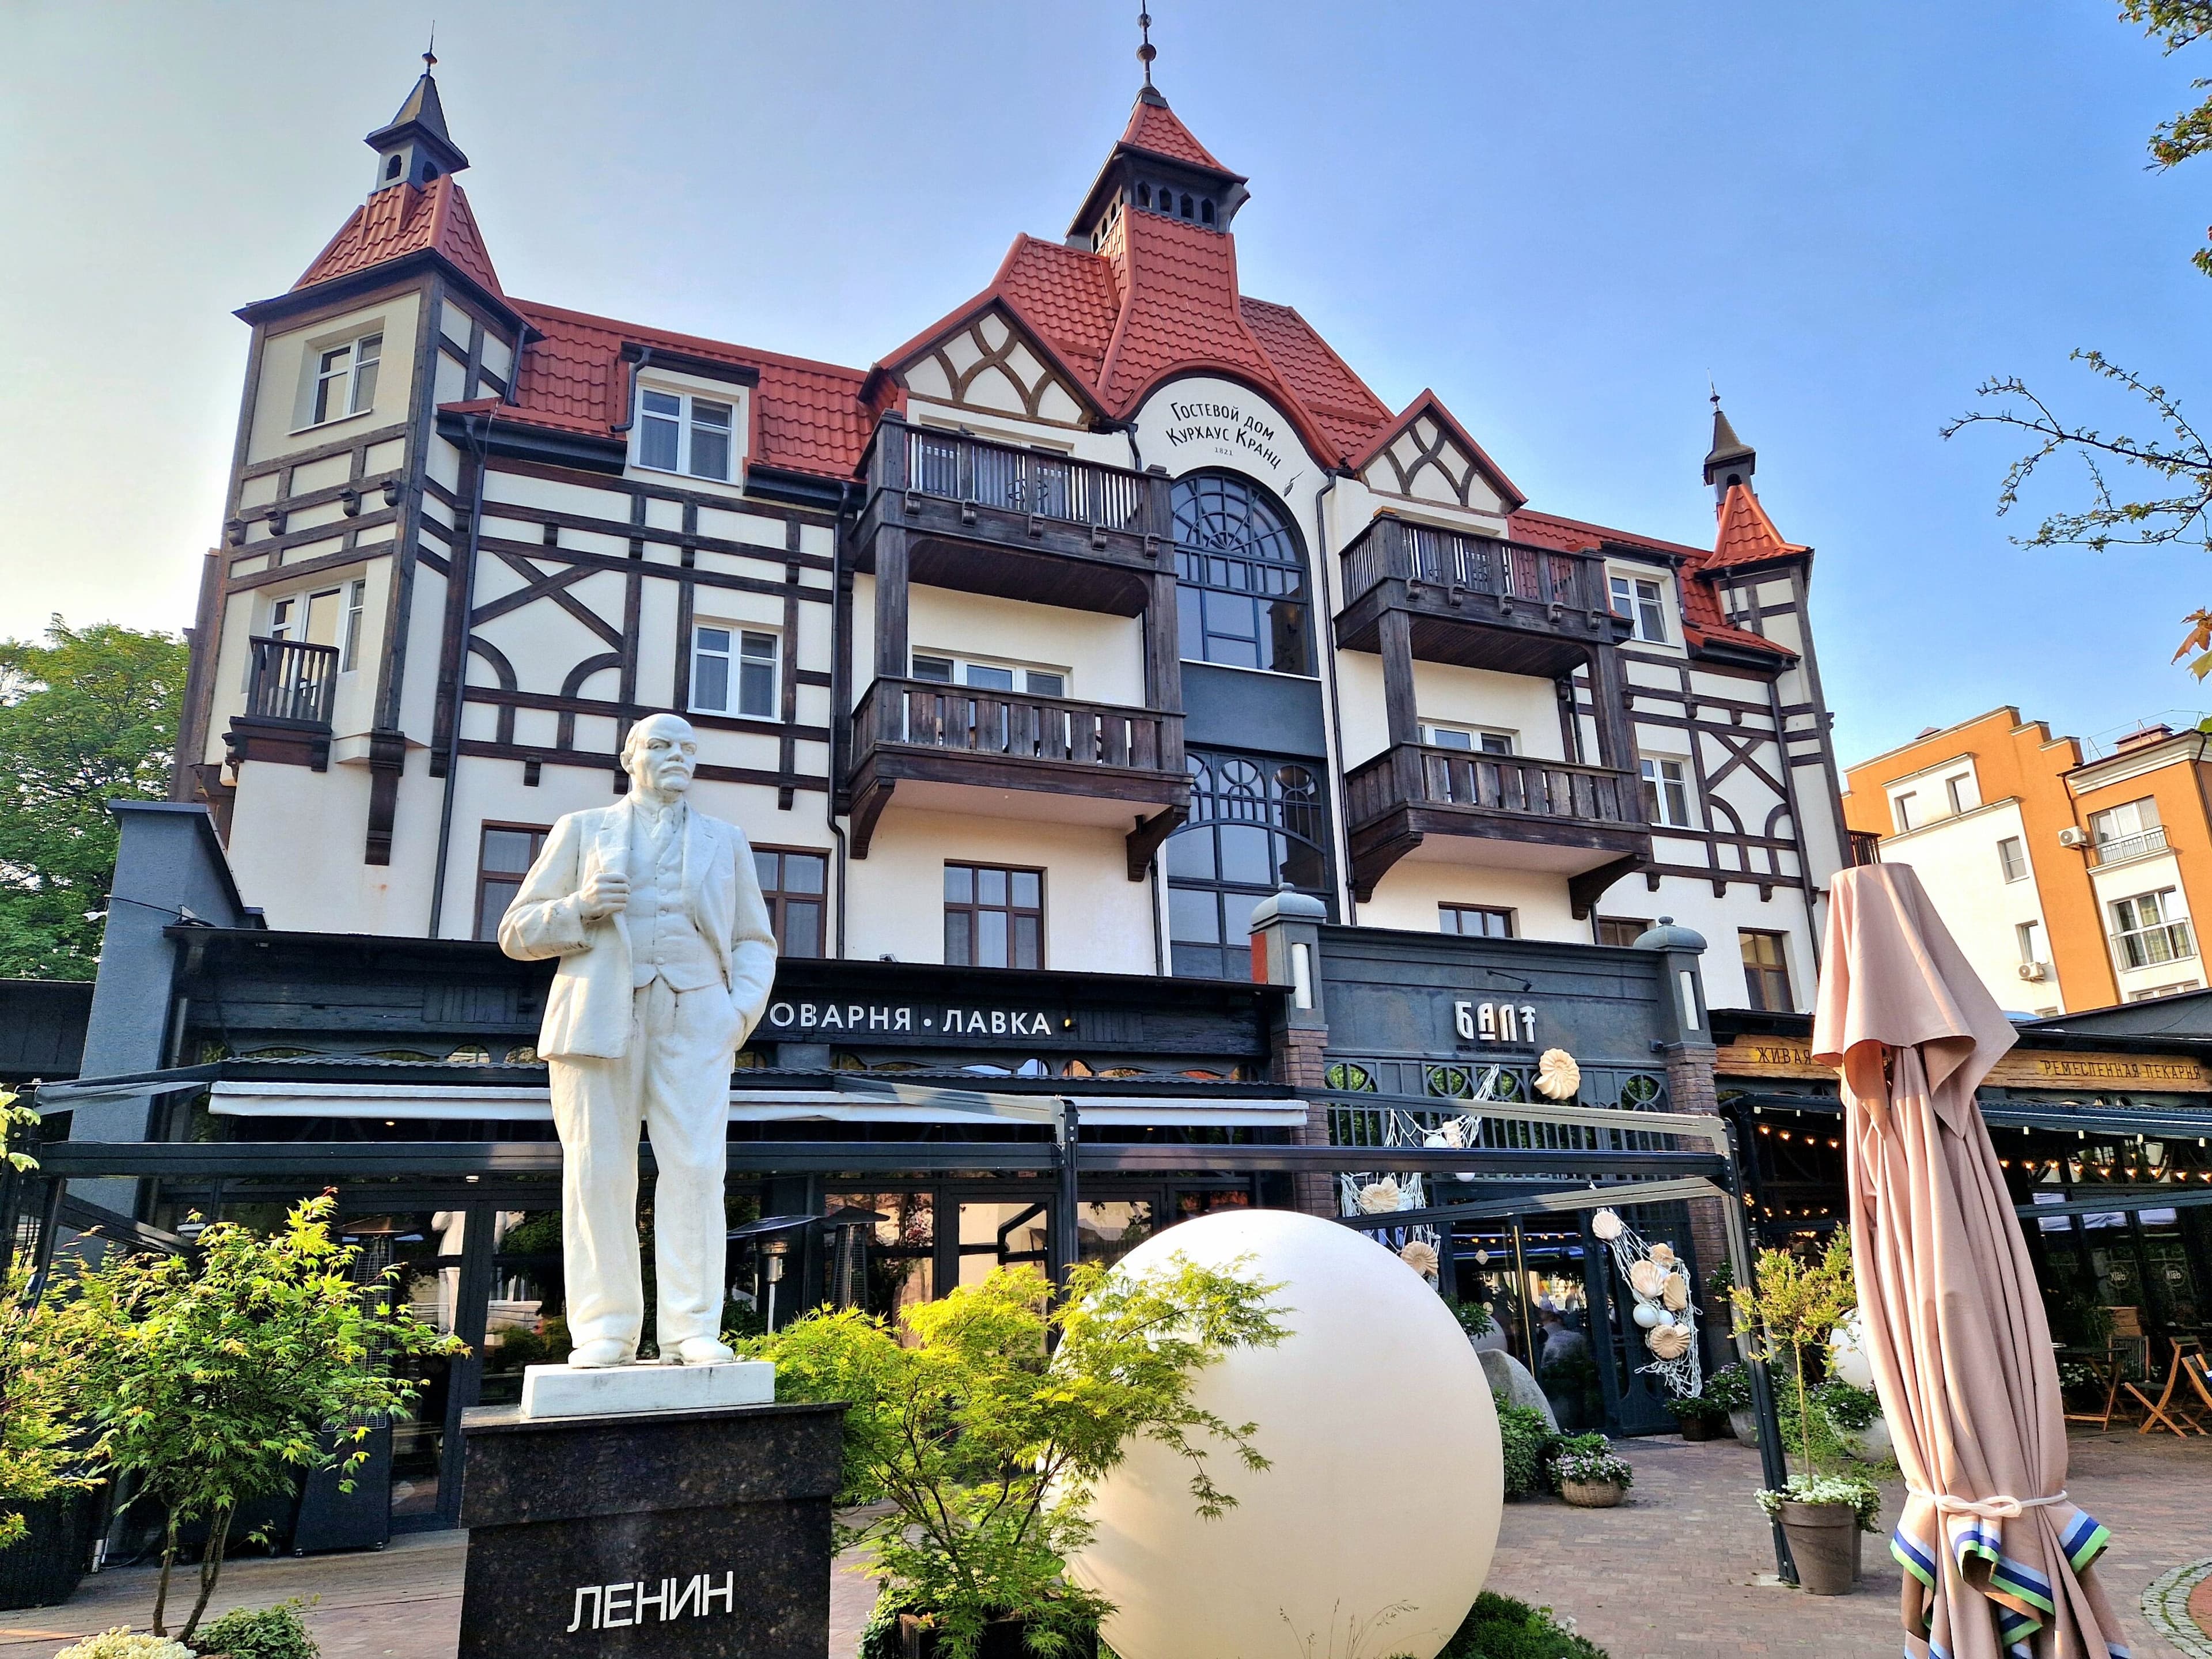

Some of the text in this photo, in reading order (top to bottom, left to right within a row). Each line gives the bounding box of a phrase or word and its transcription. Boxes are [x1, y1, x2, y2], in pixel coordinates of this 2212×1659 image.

[1171, 402, 1274, 441] ГОСТЕВОЙ ДОМ
[1166, 427, 1282, 470] КУРХАУС КРАНЦ
[1214, 446, 1233, 456] 1821
[943, 1010, 1052, 1035] ЛАВКА
[1756, 1047, 1812, 1065] ЖИВАЯ
[2040, 1060, 2200, 1080] РЕМЕСЛЕННАЯ ПЕКАРНЯ
[567, 1571, 733, 1633] ЛЕНИН
